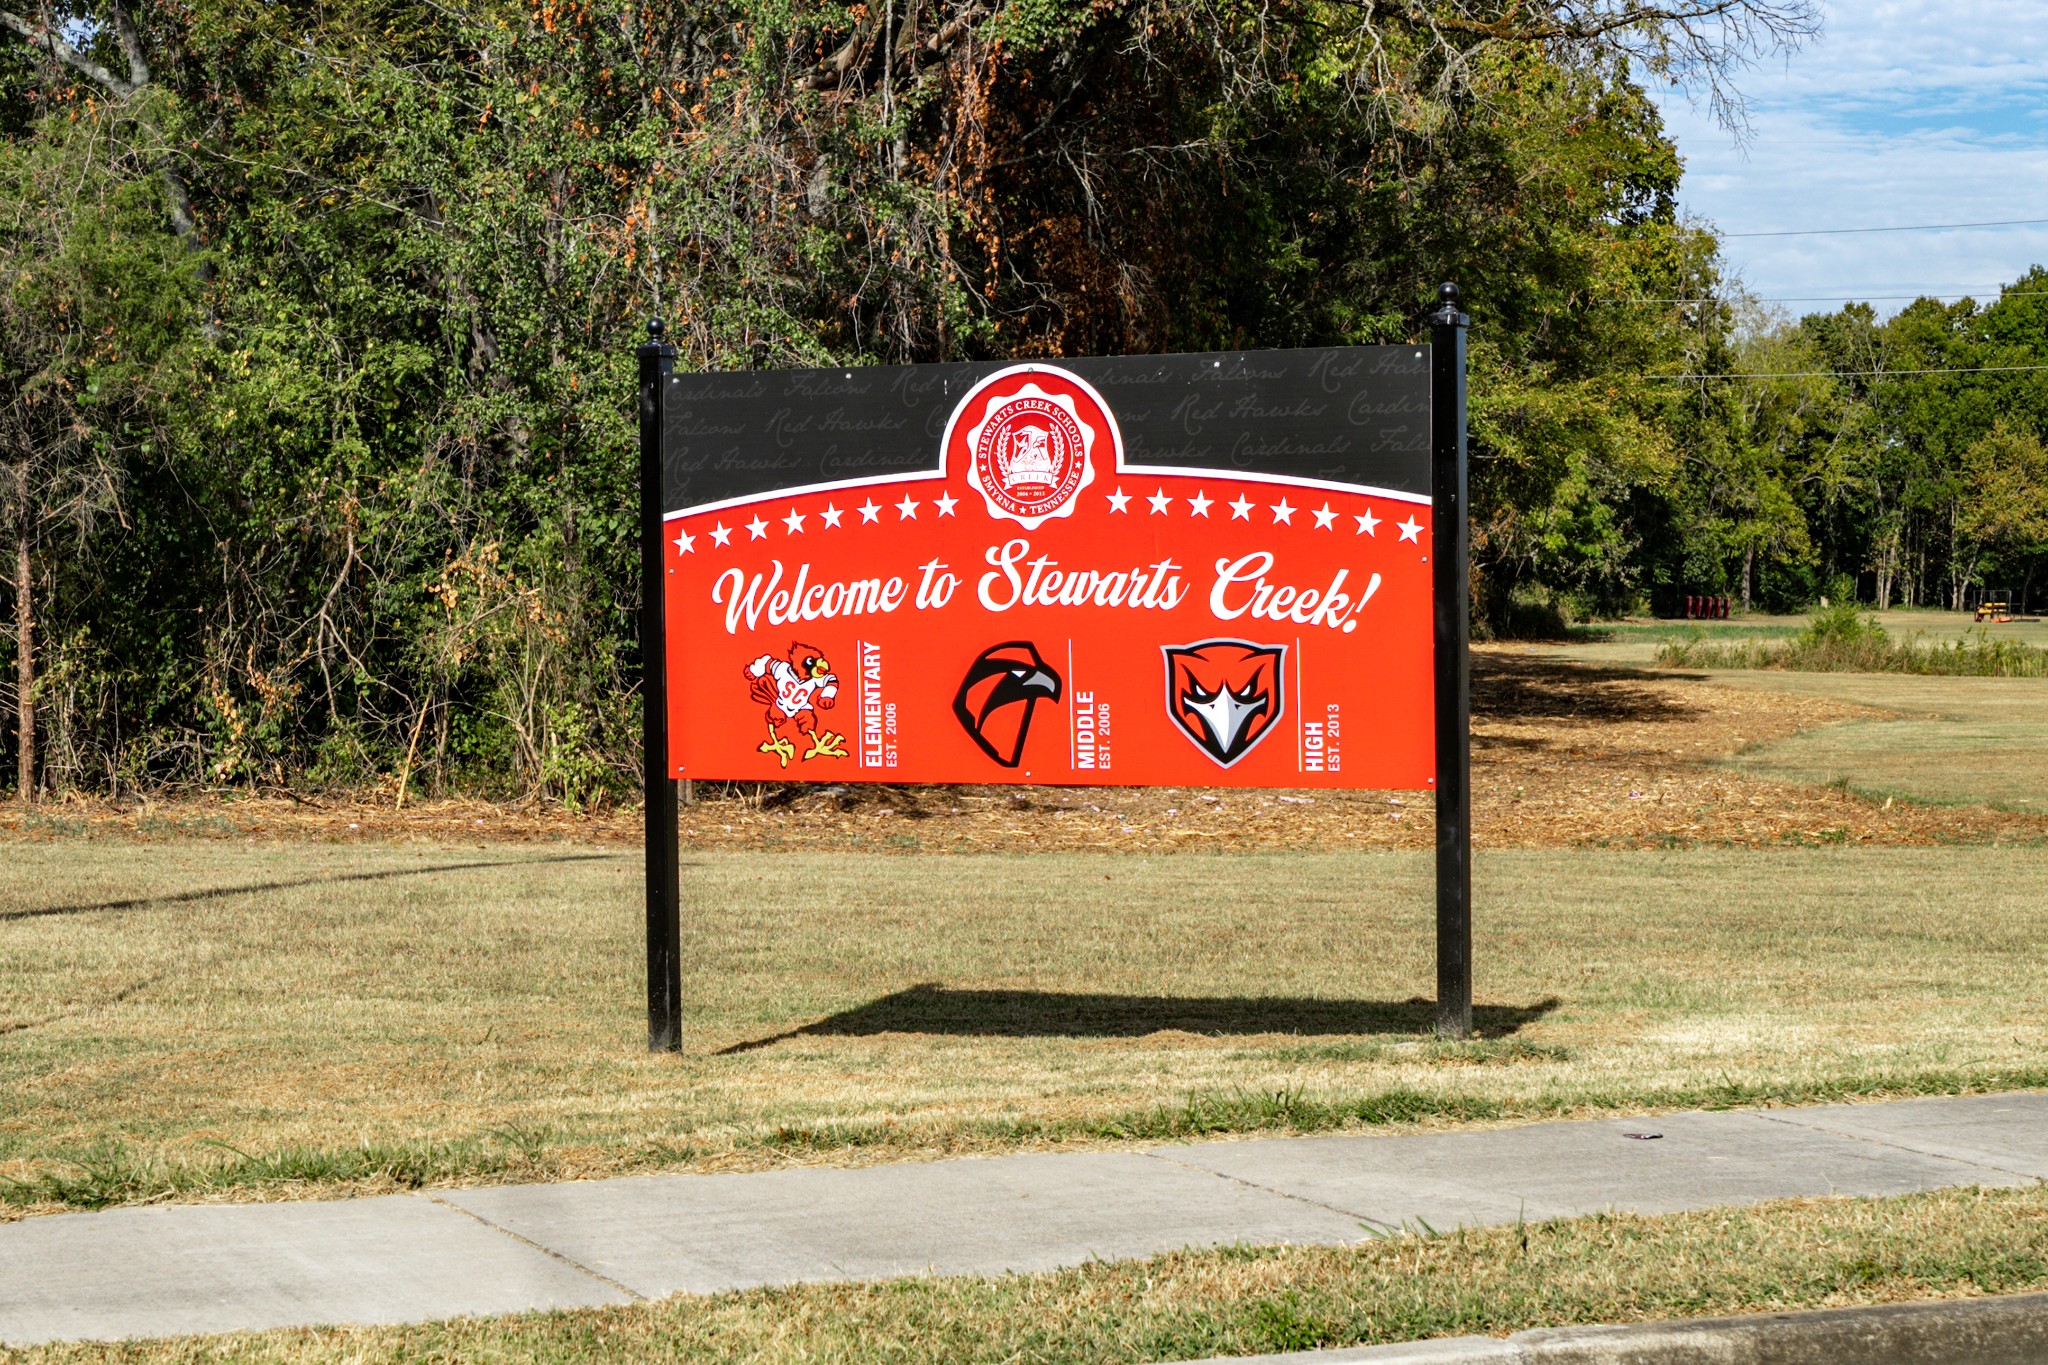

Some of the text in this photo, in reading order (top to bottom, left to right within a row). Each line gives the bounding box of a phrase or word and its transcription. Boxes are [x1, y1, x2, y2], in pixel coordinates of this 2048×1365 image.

[783, 371, 872, 397] Falcons
[889, 366, 940, 408] Red
[1191, 354, 1288, 383] Falcons
[1307, 350, 1361, 393] Red
[664, 410, 746, 436] Falcons
[764, 406, 814, 448] Red
[817, 406, 908, 432] Hawks
[978, 405, 1015, 460] STEWARTS
[1015, 399, 1052, 413] CREEK
[1051, 407, 1084, 459] SCHOOLS
[1170, 393, 1225, 436] Red
[1227, 390, 1330, 420] Hawks
[664, 443, 930, 486] Red Hawks Cardinals
[1230, 430, 1352, 468] Cardinals
[981, 471, 1081, 516] SMYRNA TENNESSEE
[711, 538, 1382, 635] Welcome to Stewarts Creek!
[782, 681, 809, 704] SC
[863, 641, 883, 768] ELEMENTARY
[885, 702, 898, 767] EST. 2006
[1076, 691, 1095, 769] MIDDLE
[1097, 703, 1111, 769] EST. 2006
[1304, 722, 1324, 772] HIGH
[1327, 703, 1340, 772] EST. 2013
